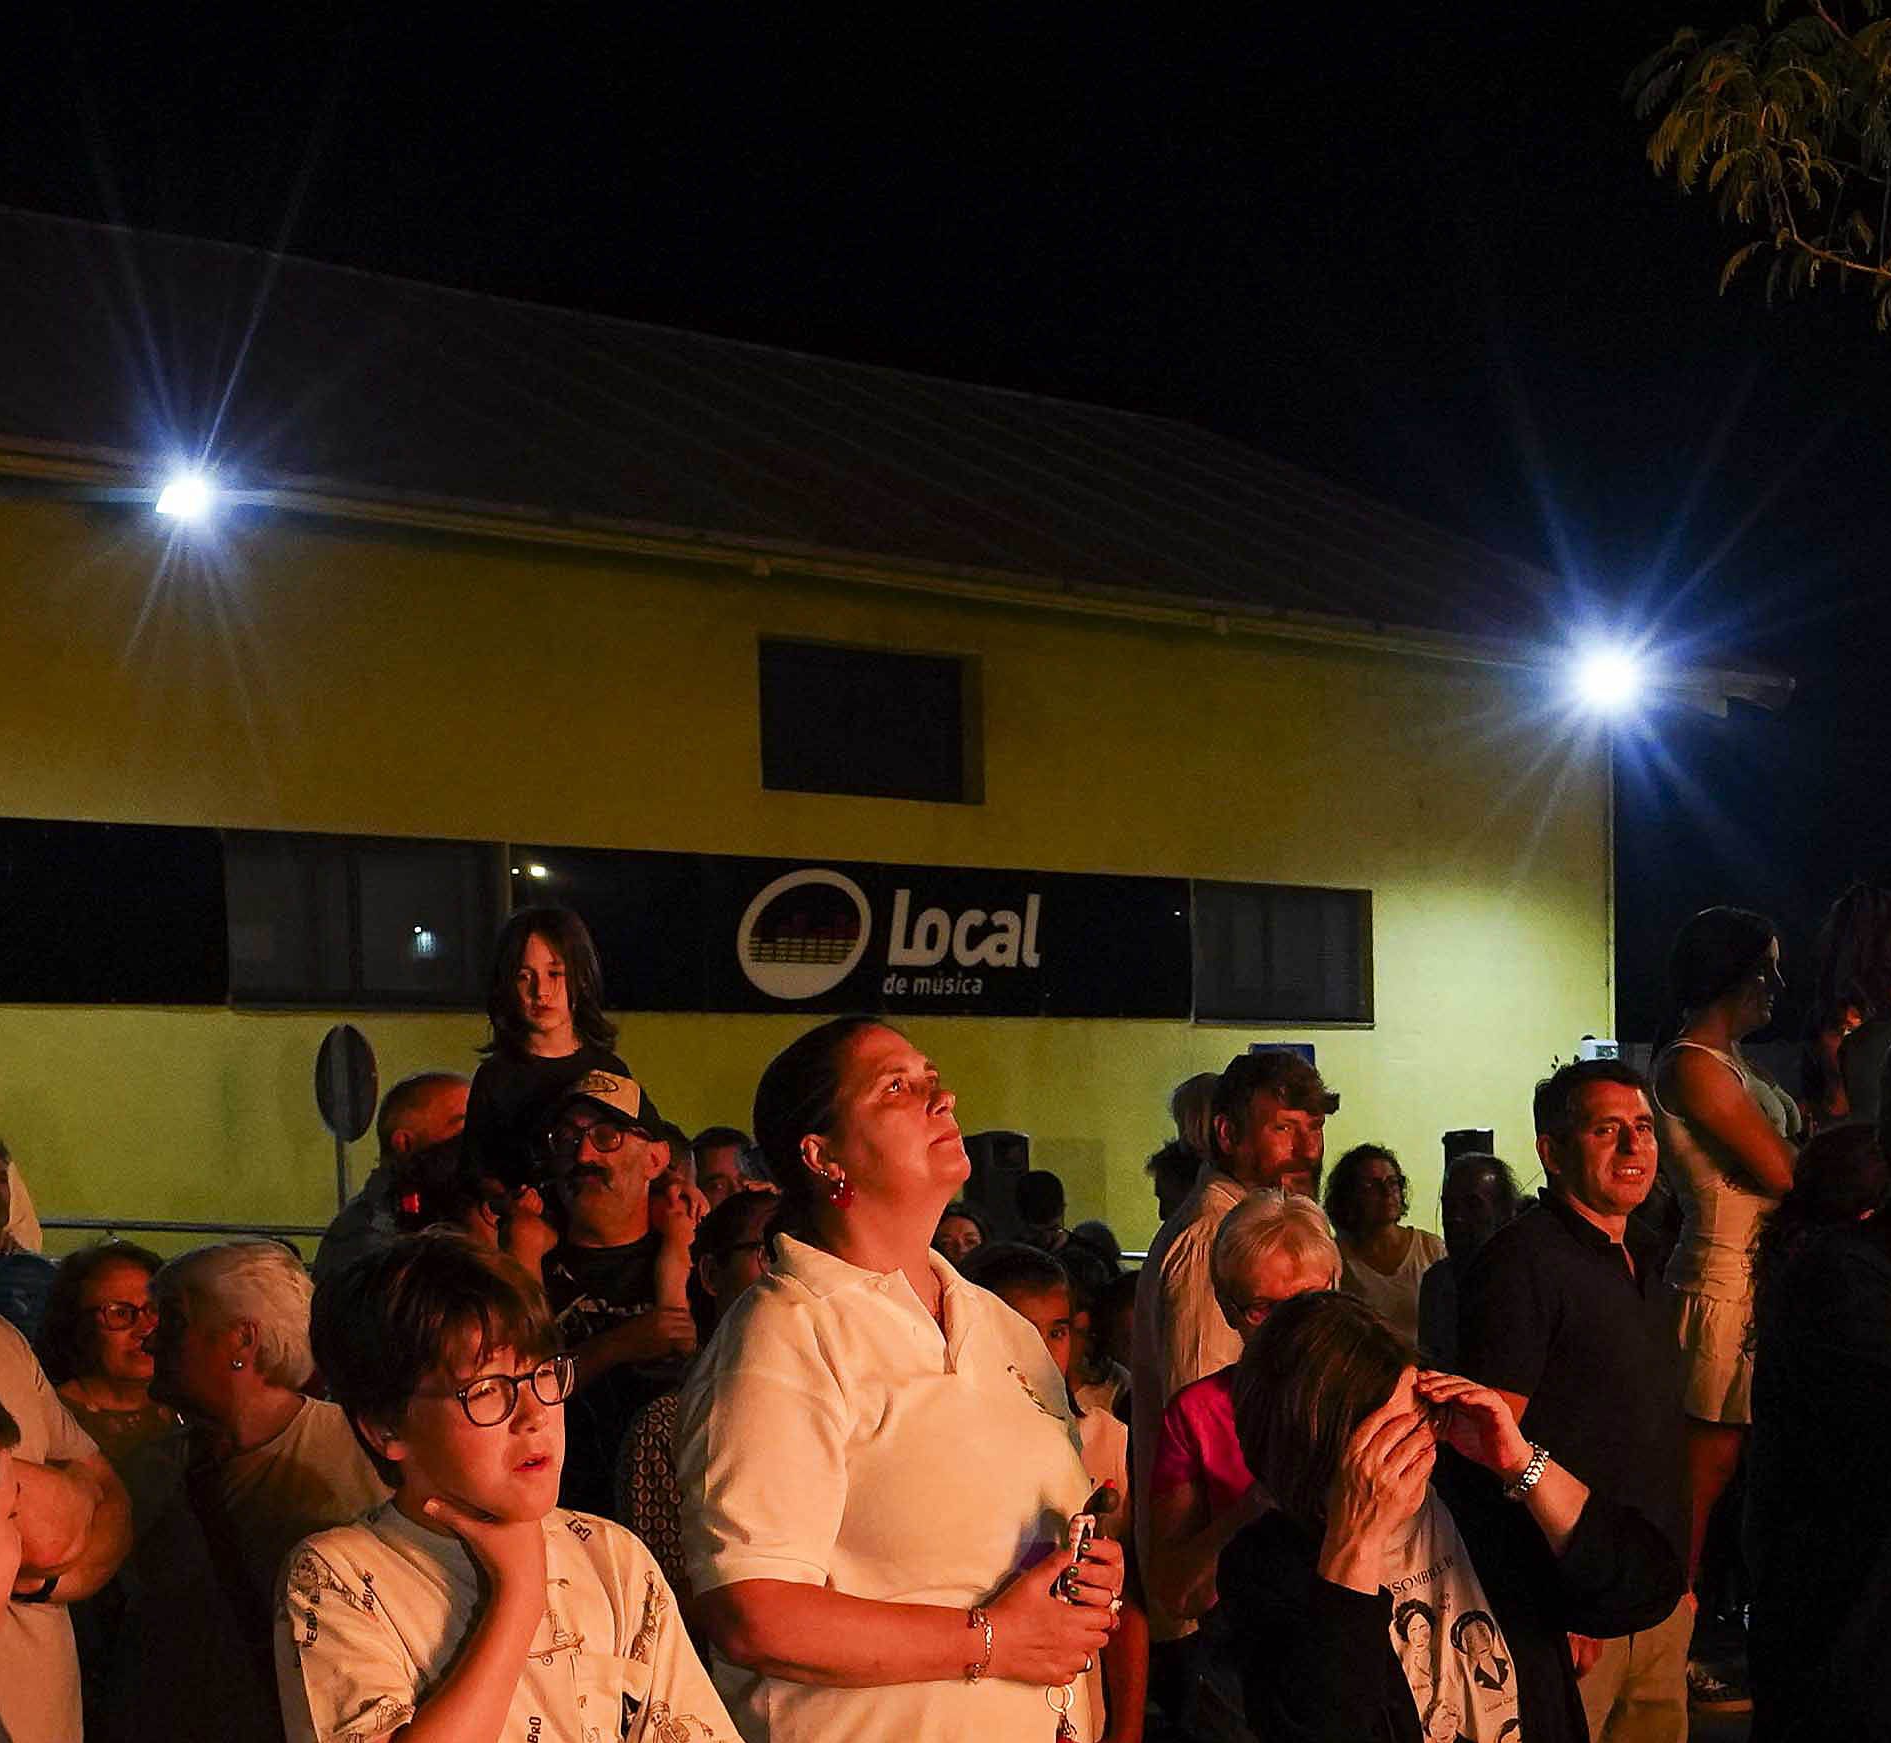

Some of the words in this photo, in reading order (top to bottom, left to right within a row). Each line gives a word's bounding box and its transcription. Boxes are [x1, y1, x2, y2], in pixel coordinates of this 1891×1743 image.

[888, 888, 1041, 968] Local
[882, 973, 907, 994] de
[912, 970, 983, 995] música
